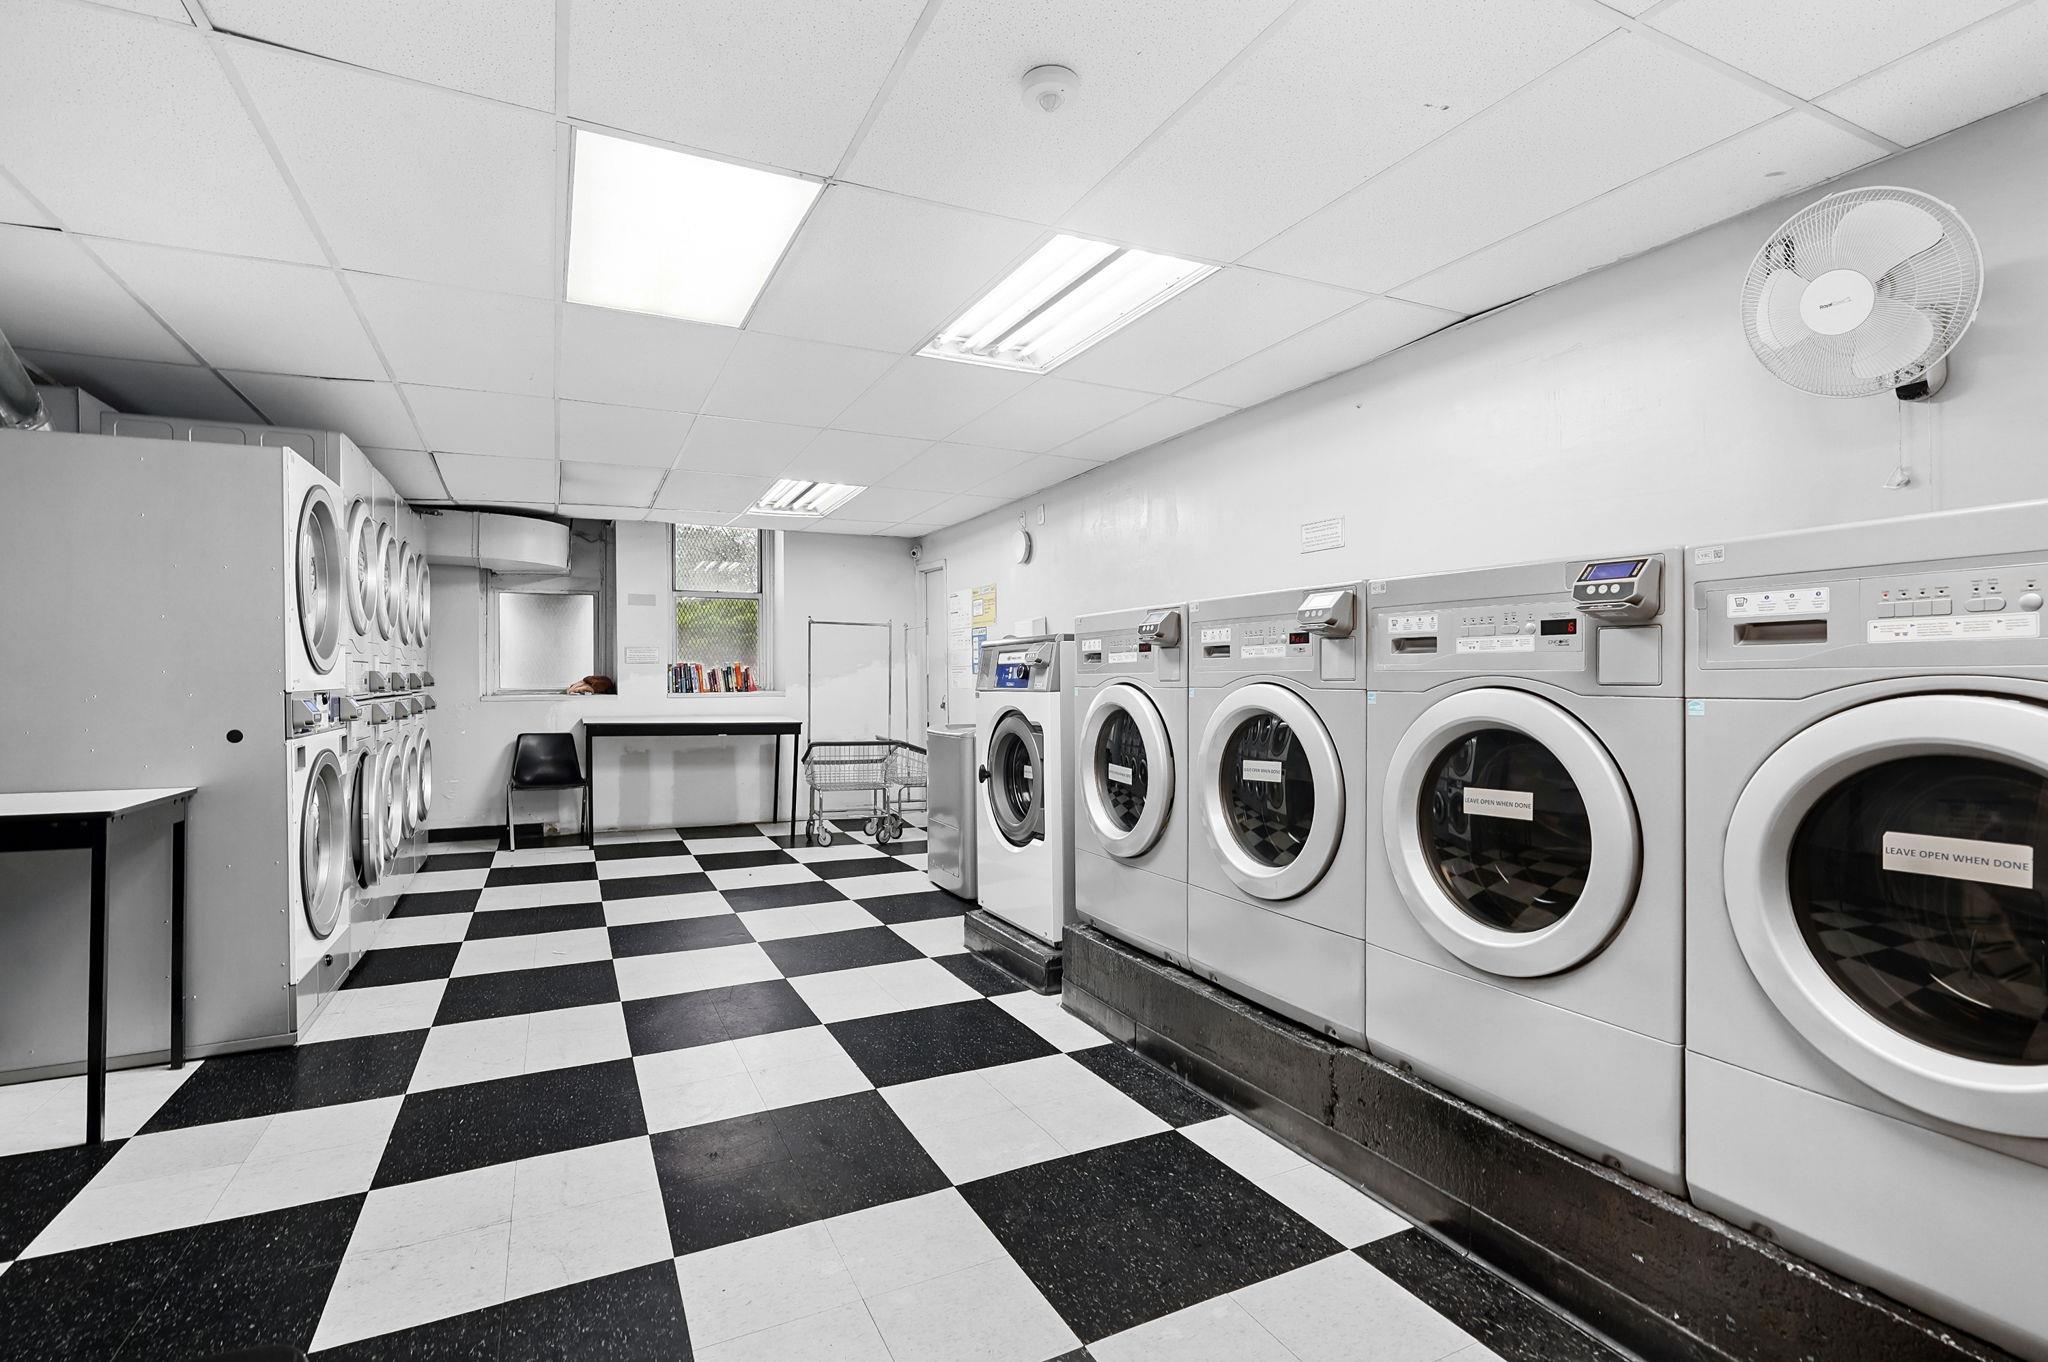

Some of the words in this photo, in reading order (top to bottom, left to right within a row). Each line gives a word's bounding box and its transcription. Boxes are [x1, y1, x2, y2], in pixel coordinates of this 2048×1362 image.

[1885, 846, 1916, 858] LEAVE
[1919, 850, 1950, 861] OPEN
[1952, 854, 1990, 867] WHEN
[1993, 859, 2029, 871] DONE
